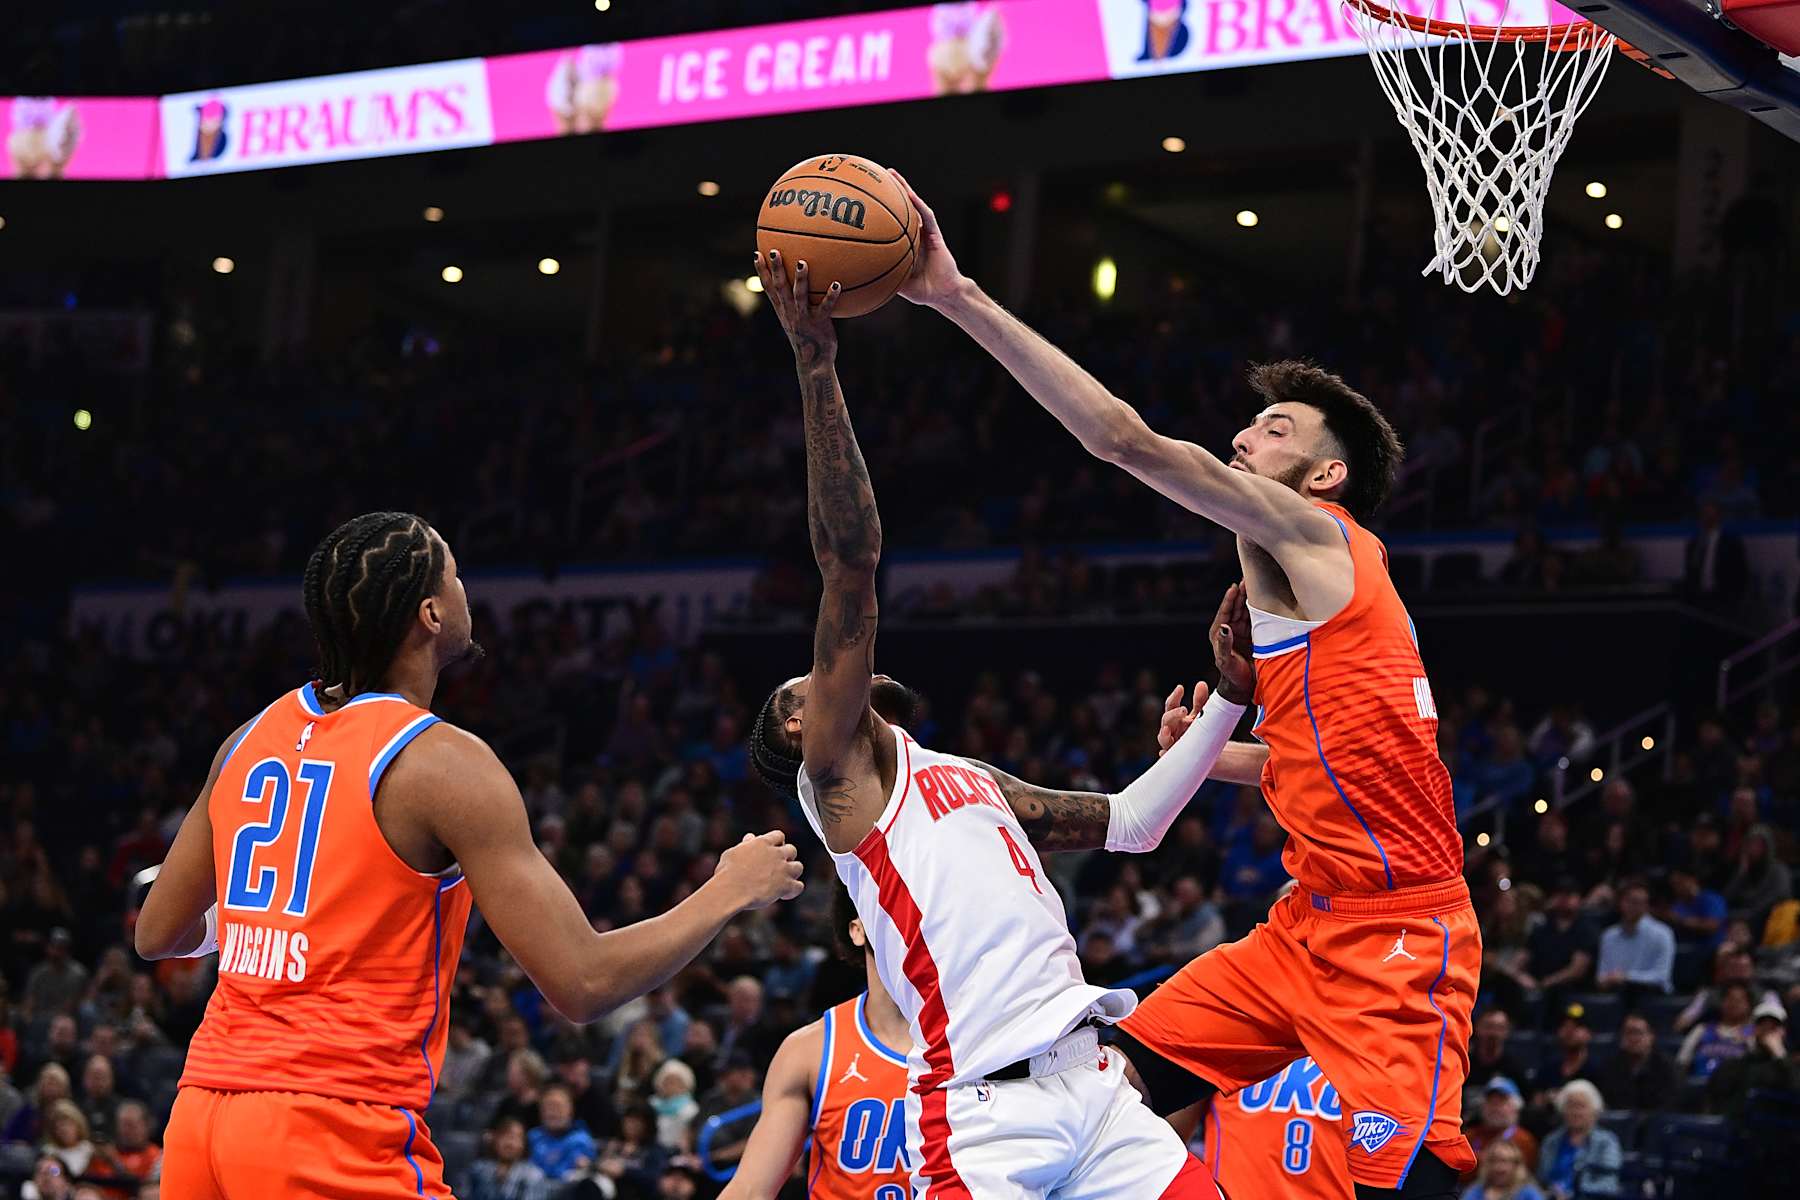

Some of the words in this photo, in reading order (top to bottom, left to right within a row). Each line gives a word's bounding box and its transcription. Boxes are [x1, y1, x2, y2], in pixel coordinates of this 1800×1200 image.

[658, 47, 731, 106] ICE
[743, 29, 894, 96] CREAM
[238, 83, 468, 158] BRAUM'S
[769, 187, 866, 231] Wilson
[913, 765, 1016, 823] ROCKET
[224, 757, 335, 917] 21
[997, 826, 1043, 895] 4
[218, 922, 309, 983] WIGGINS
[837, 1097, 913, 1174] OK
[1282, 1118, 1314, 1175] 8
[1353, 1121, 1388, 1141] OKC
